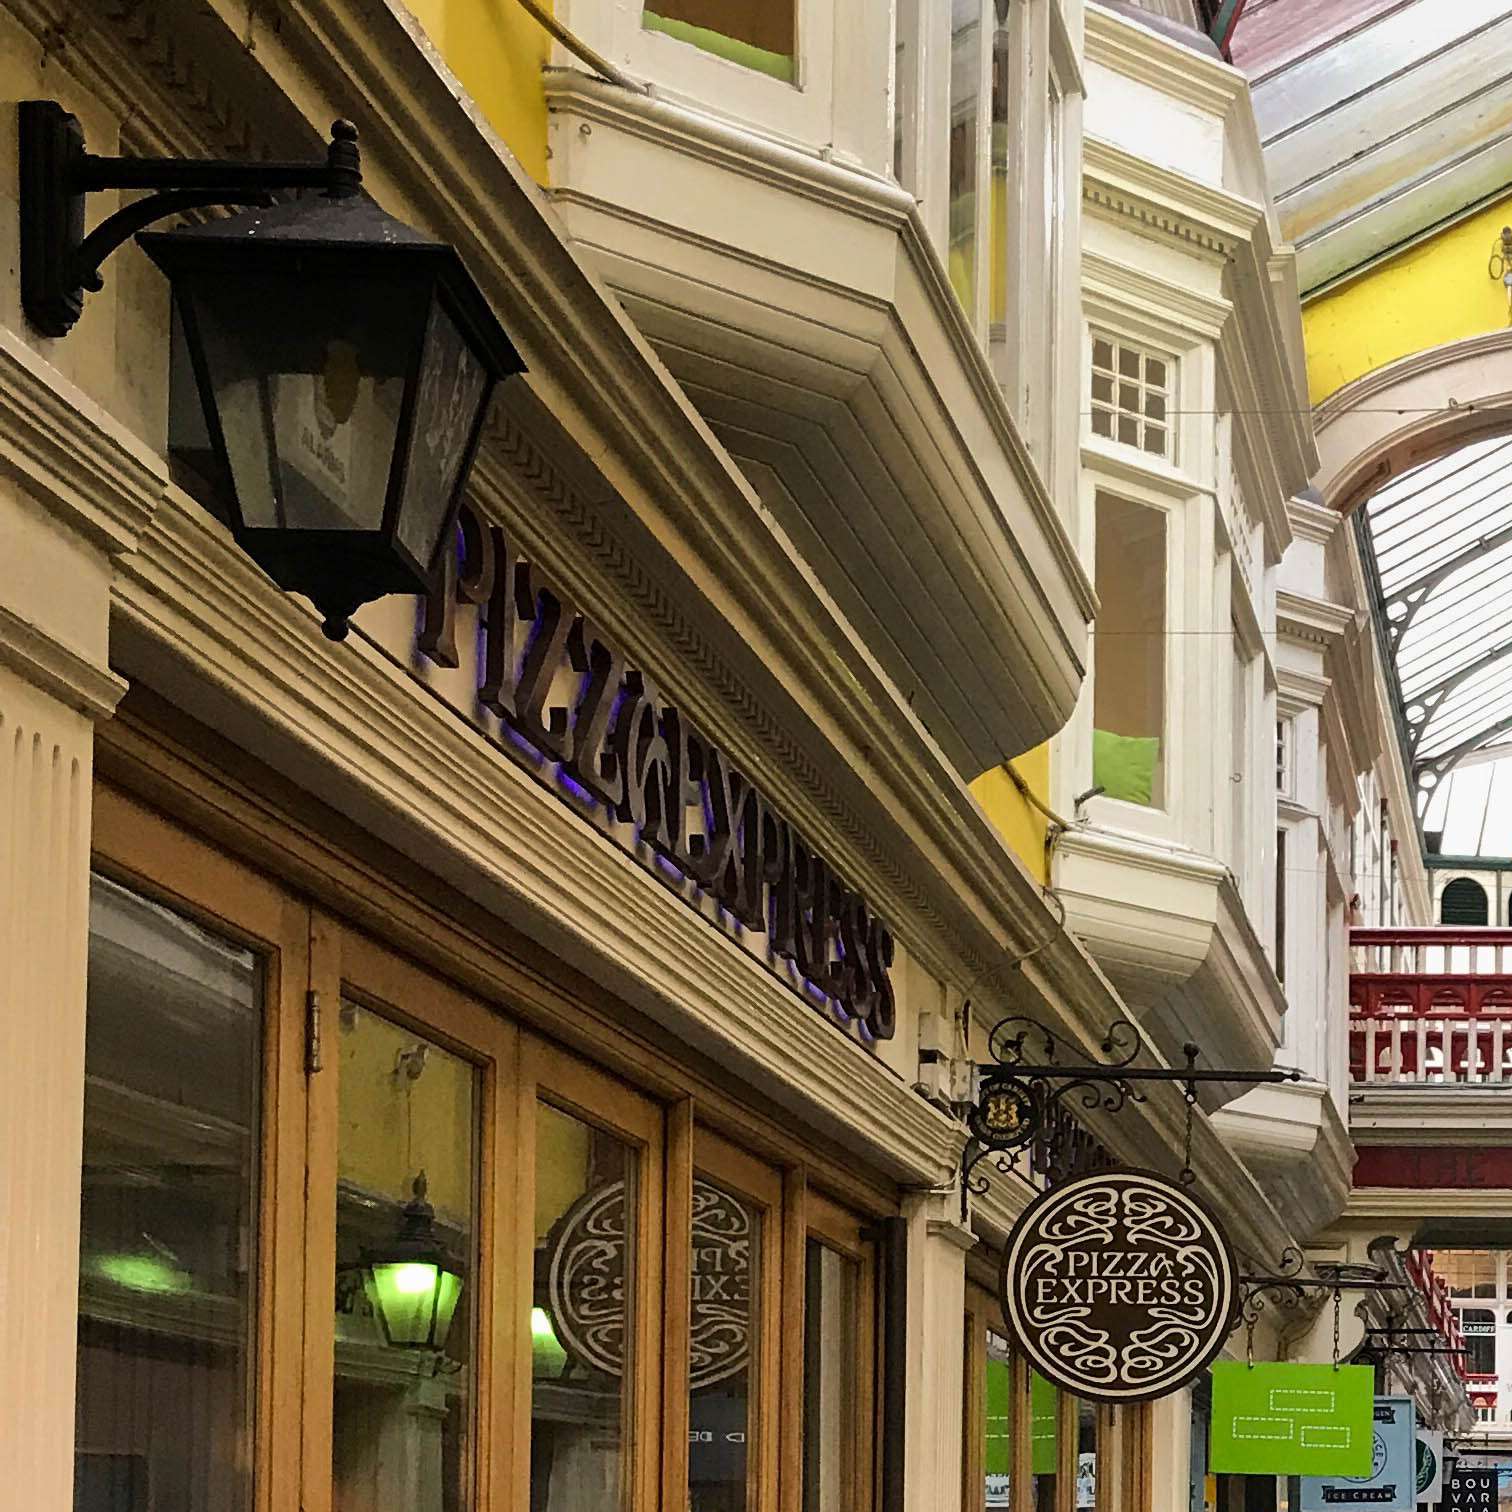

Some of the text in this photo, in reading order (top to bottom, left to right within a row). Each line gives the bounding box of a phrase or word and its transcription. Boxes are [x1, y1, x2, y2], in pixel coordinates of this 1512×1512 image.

[1411, 1150, 1486, 1185] THE
[1066, 1250, 1175, 1278] PIZZA
[1036, 1278, 1206, 1305] EXPRESS
[1462, 1325, 1496, 1334] CARDIFF
[1451, 1478, 1491, 1490] BOU
[1327, 1490, 1393, 1501] ICE CREAM
